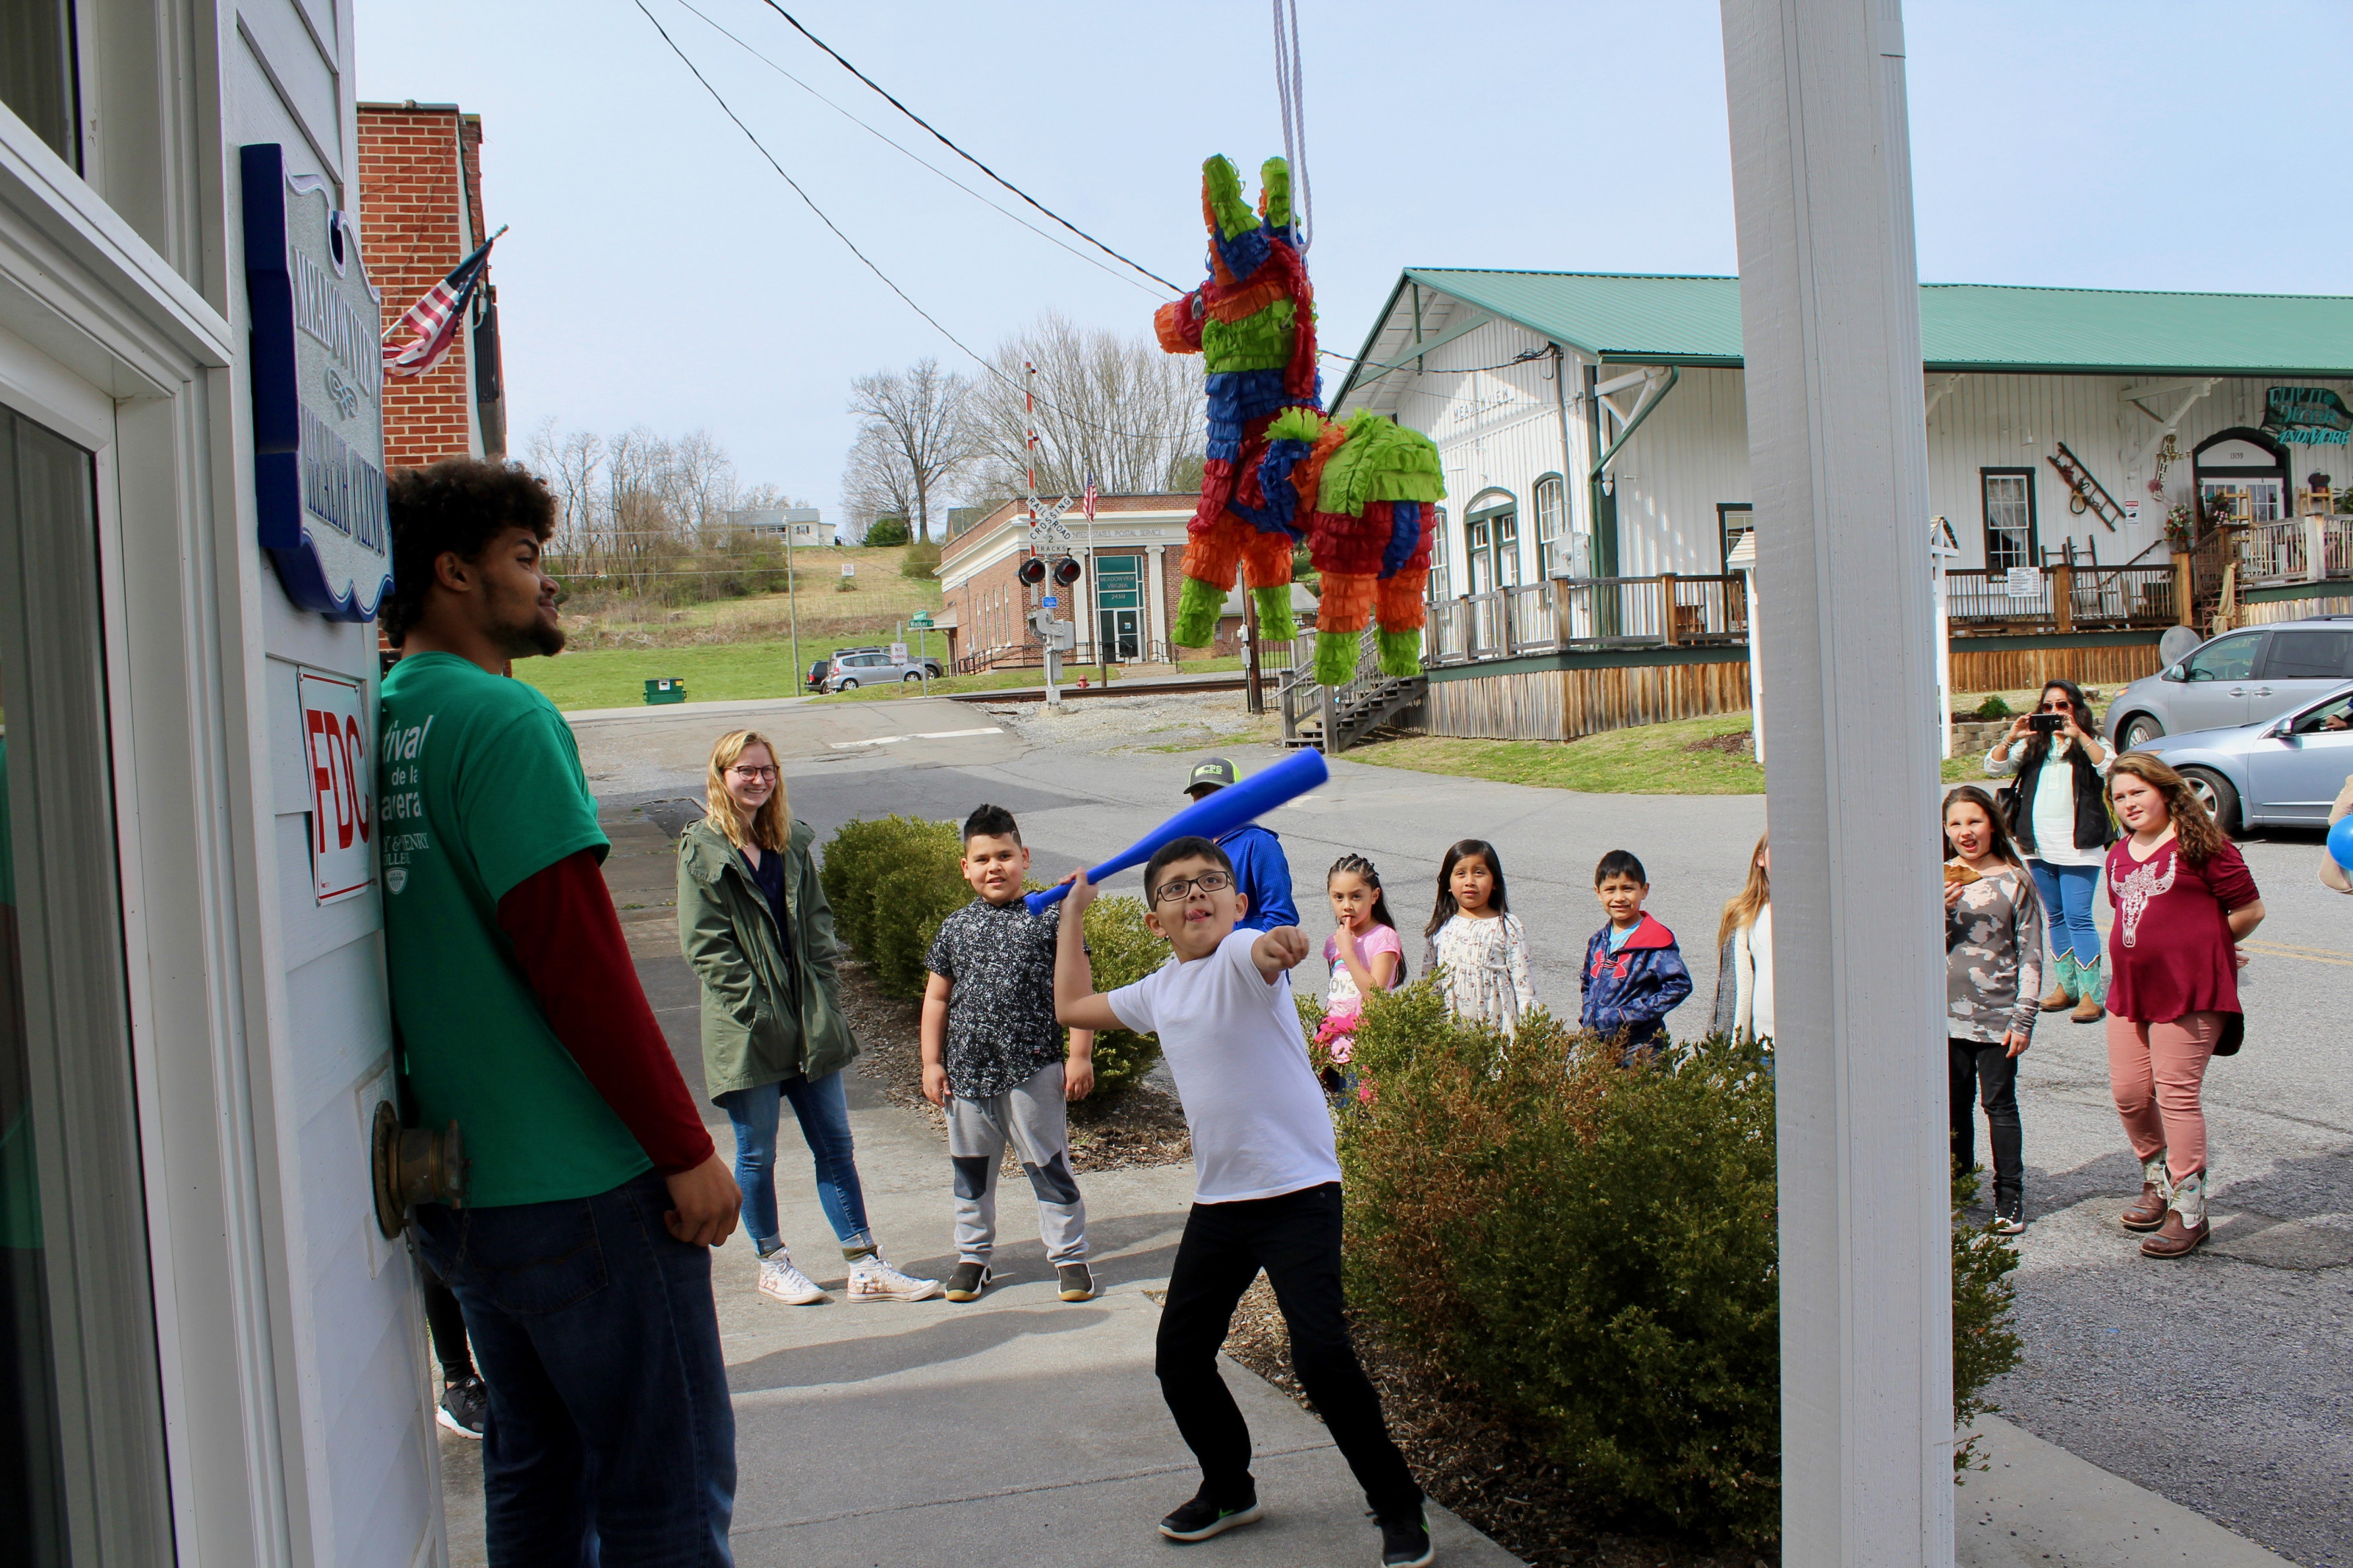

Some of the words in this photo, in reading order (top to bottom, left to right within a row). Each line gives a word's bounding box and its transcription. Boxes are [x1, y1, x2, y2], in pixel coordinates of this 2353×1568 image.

[294, 246, 377, 408] MEADOWVIEW
[1454, 387, 1508, 420] MEADOWVIEW
[2268, 387, 2305, 407] FLIP
[2308, 388, 2326, 404] IT
[2280, 404, 2339, 424] DECOR
[2275, 429, 2308, 445] AND
[2305, 427, 2352, 445] MORE
[300, 402, 351, 536] HEALTH
[352, 448, 386, 557] CLINIC
[1029, 498, 1071, 540] CROSSING
[1048, 535, 1054, 543] 2
[306, 709, 370, 853] FDC
[392, 767, 406, 786] de
[410, 765, 418, 784] la
[381, 791, 422, 821] aera
[392, 837, 401, 852] &
[1331, 978, 1355, 994] OVE
